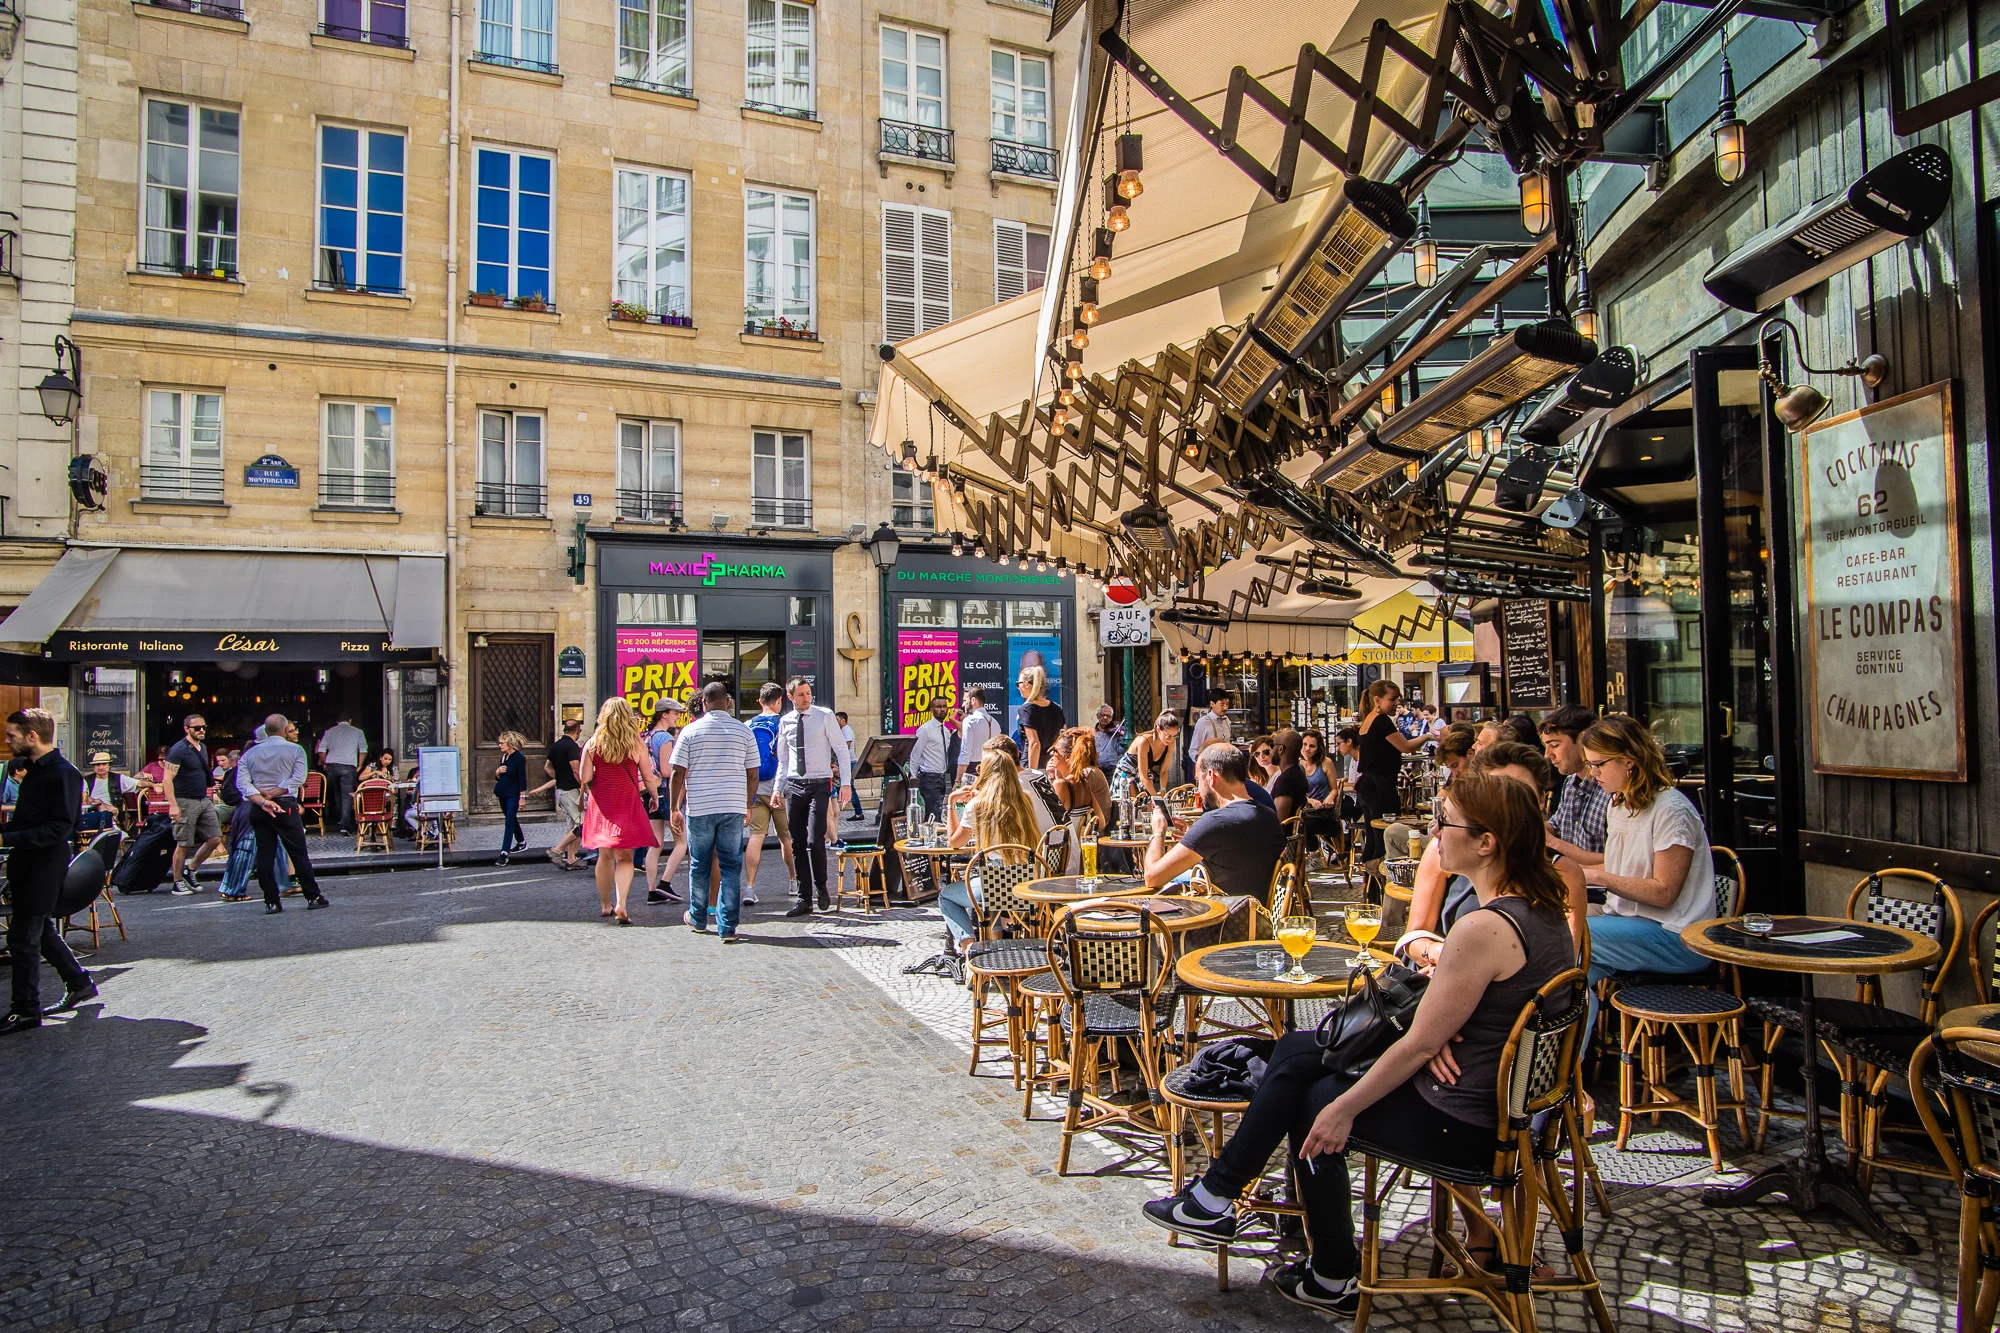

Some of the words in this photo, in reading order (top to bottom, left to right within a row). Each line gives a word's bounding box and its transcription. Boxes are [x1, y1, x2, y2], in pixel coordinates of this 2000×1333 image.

[1826, 440, 1920, 488] COCKTAILS
[248, 477, 295, 485] MONTORGUEIL
[576, 495, 590, 505] 49
[1857, 489, 1889, 518] 62
[1826, 529, 1845, 543] RUE
[1849, 514, 1927, 539] MONTORGUEIL
[1846, 547, 1906, 568] CAFE-BAR
[897, 571, 915, 581] DU
[919, 571, 972, 582] MARCHÉ
[976, 573, 1063, 585] MONTORGUEIL
[1837, 565, 1918, 588] RESTAURANT
[1109, 610, 1141, 621] SAUF
[1820, 607, 1843, 641] LE
[1849, 595, 1943, 638] COMPAS
[69, 640, 129, 651] Ristorante
[139, 640, 184, 651] Italiano
[214, 633, 280, 652] César
[341, 641, 370, 652] Pizza
[651, 638, 697, 646] RÉFÉRENCES
[1362, 650, 1413, 661] STOHRER
[1438, 649, 1473, 659] TAITEU
[1856, 649, 1902, 663] SERVICE
[975, 662, 1002, 670] CHOIX,
[1856, 662, 1904, 675] CONTINU
[624, 660, 696, 693] PRIX
[903, 660, 956, 690] PRIX
[88, 685, 123, 696] GIORNO
[1826, 690, 1943, 731] CHAMPAGNES
[904, 713, 913, 728] SUR
